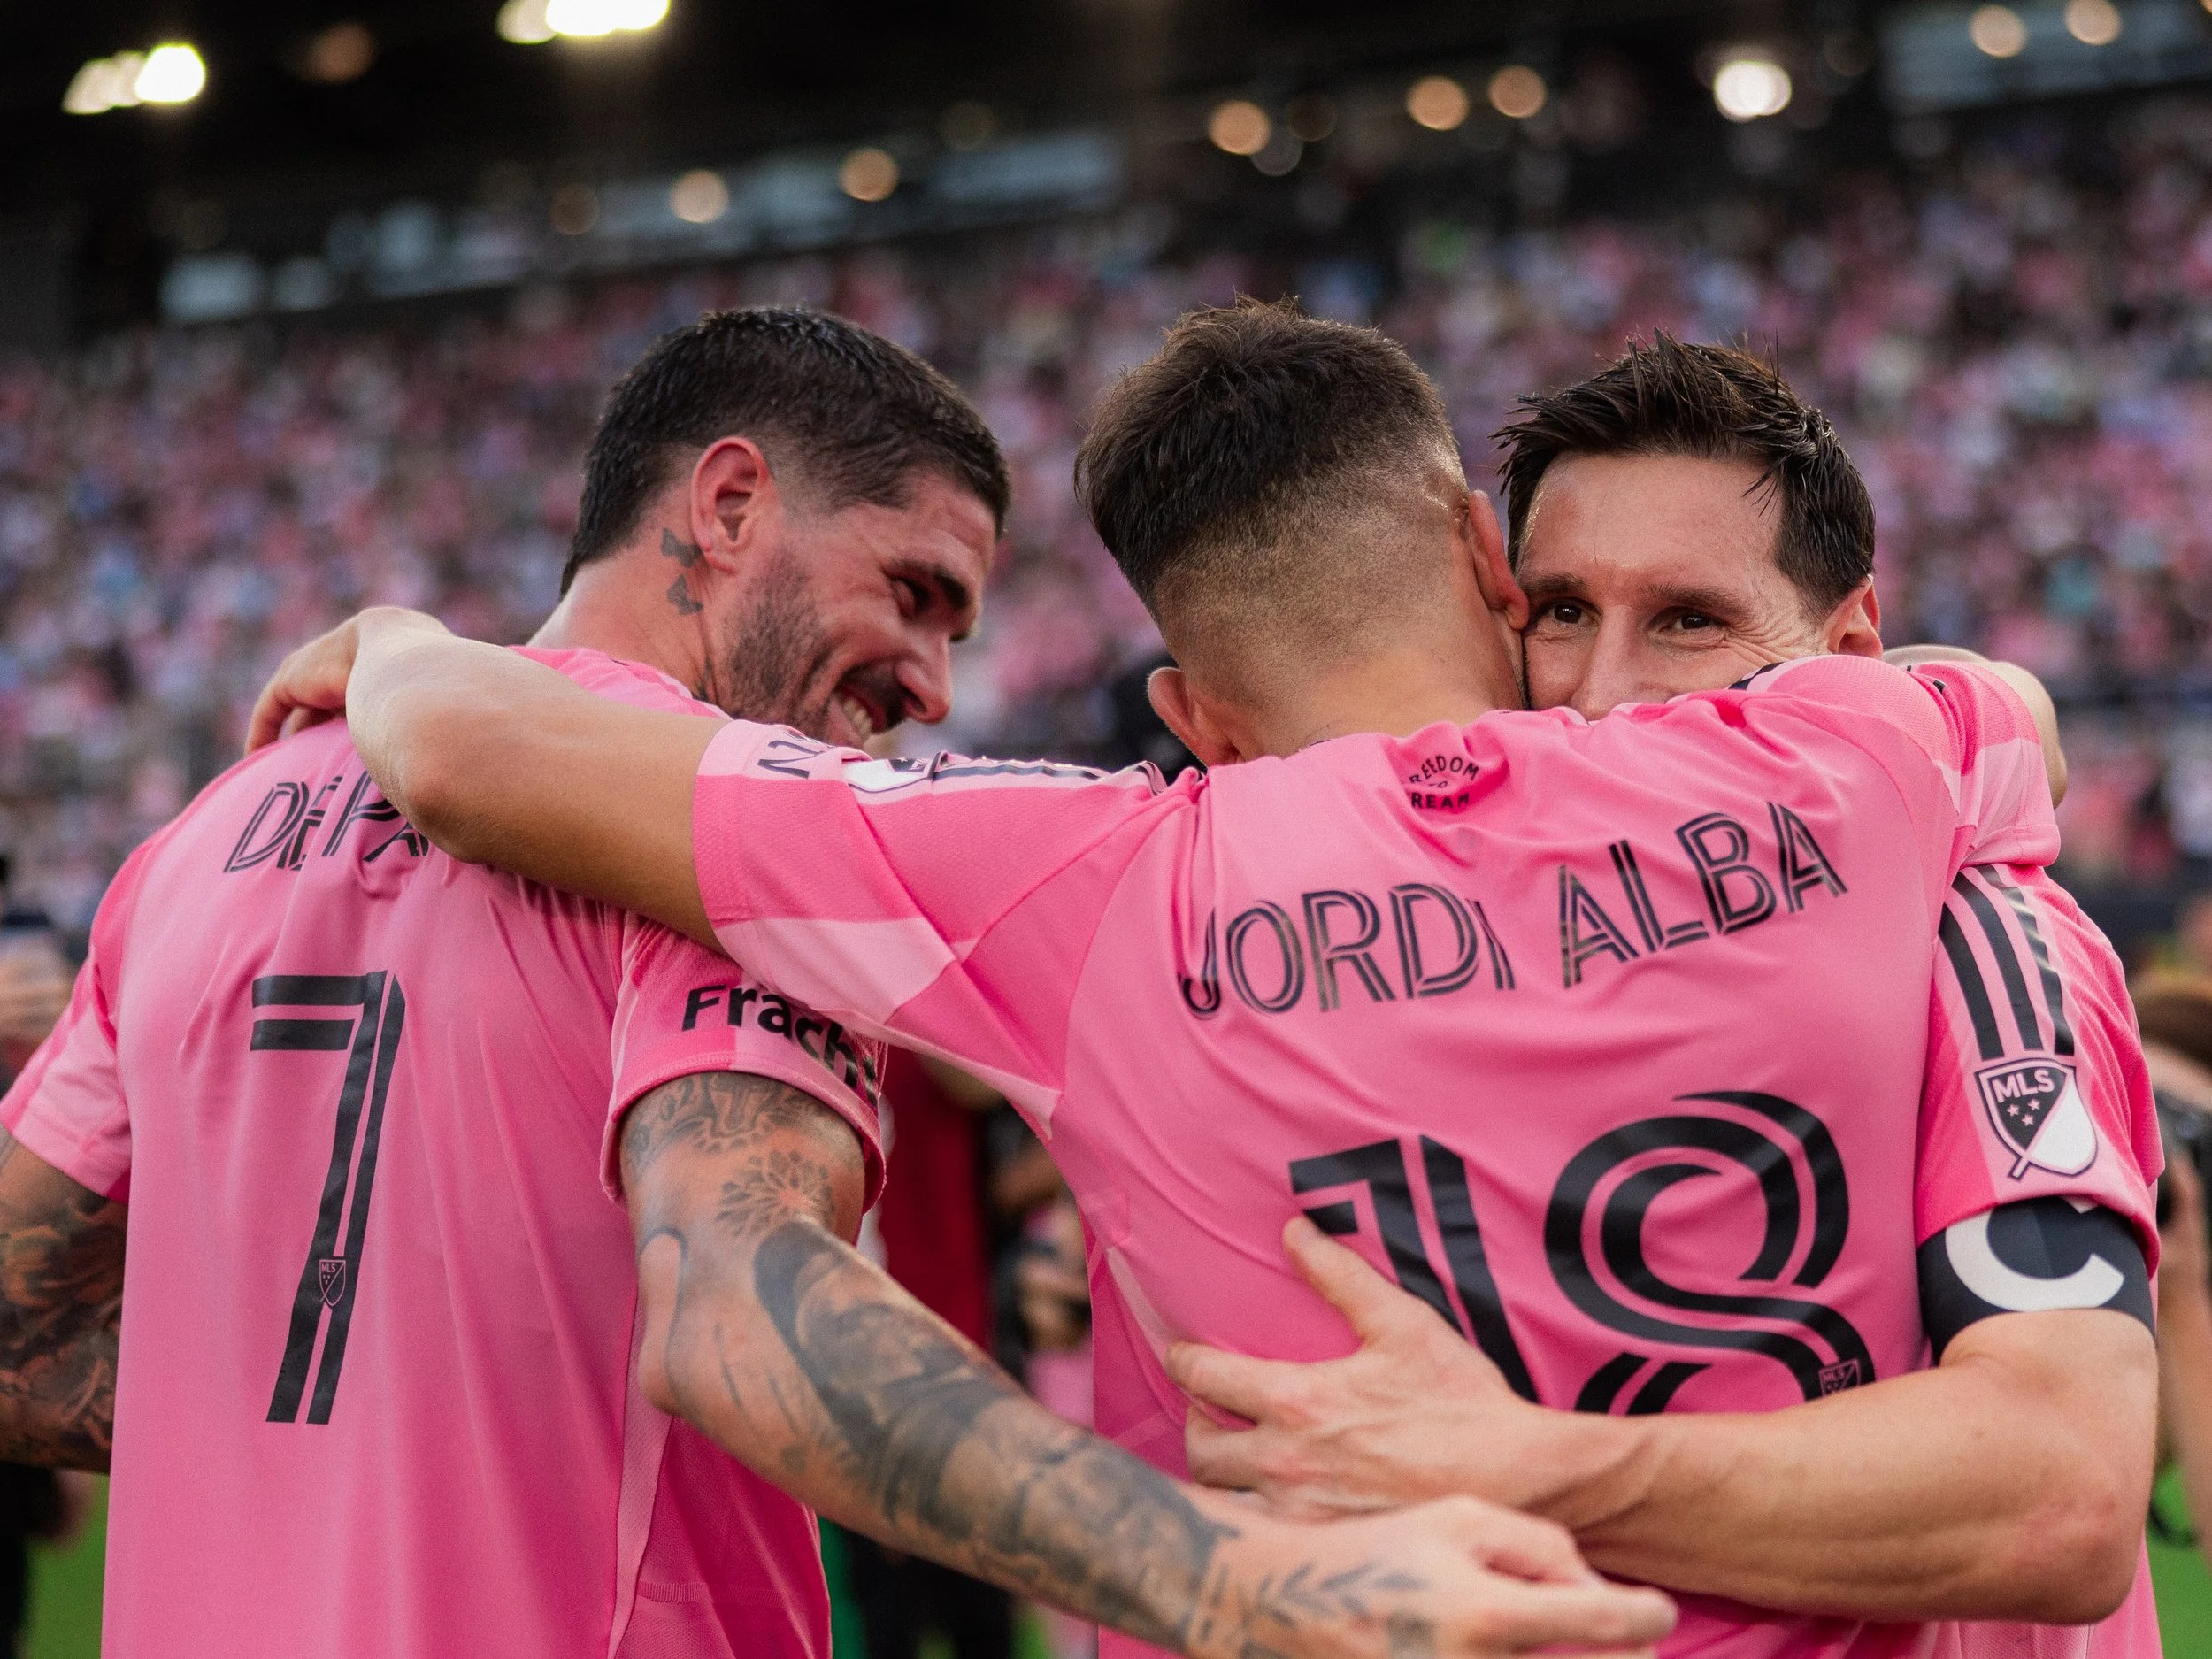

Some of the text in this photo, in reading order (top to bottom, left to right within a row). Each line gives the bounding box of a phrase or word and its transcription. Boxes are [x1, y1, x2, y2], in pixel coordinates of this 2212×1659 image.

[1409, 756, 1479, 783] REEDOM
[321, 770, 429, 863] PA
[1410, 792, 1469, 809] REAM
[1178, 801, 1848, 1017] JORDI ALBA
[1993, 1070, 2055, 1102] MLS
[250, 969, 406, 1425] 7
[321, 1263, 336, 1273] MLS
